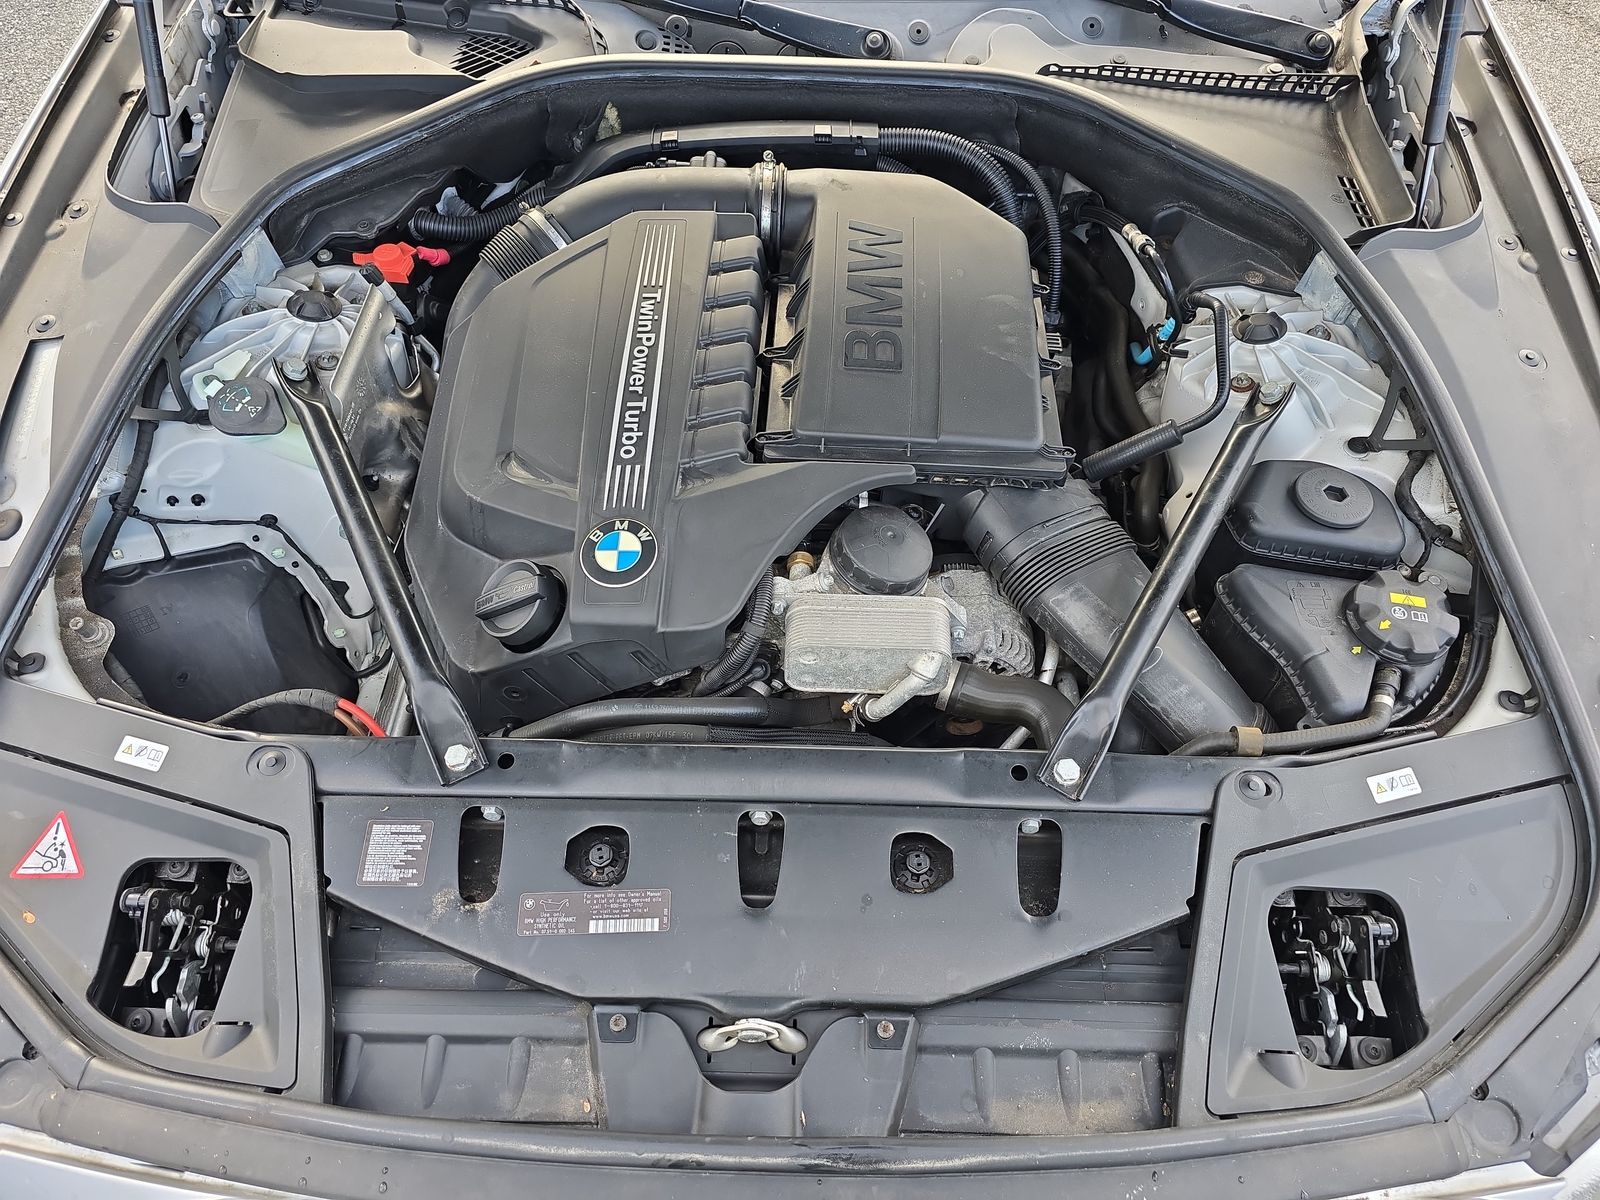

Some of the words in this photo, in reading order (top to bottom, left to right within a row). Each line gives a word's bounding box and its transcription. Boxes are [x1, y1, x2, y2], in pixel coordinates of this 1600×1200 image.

[843, 219, 904, 371] BMW
[627, 288, 664, 395] TwinPower
[619, 397, 648, 460] Turbo
[589, 520, 654, 543] BMW
[476, 594, 495, 610] BMW
[512, 582, 535, 594] Castrol
